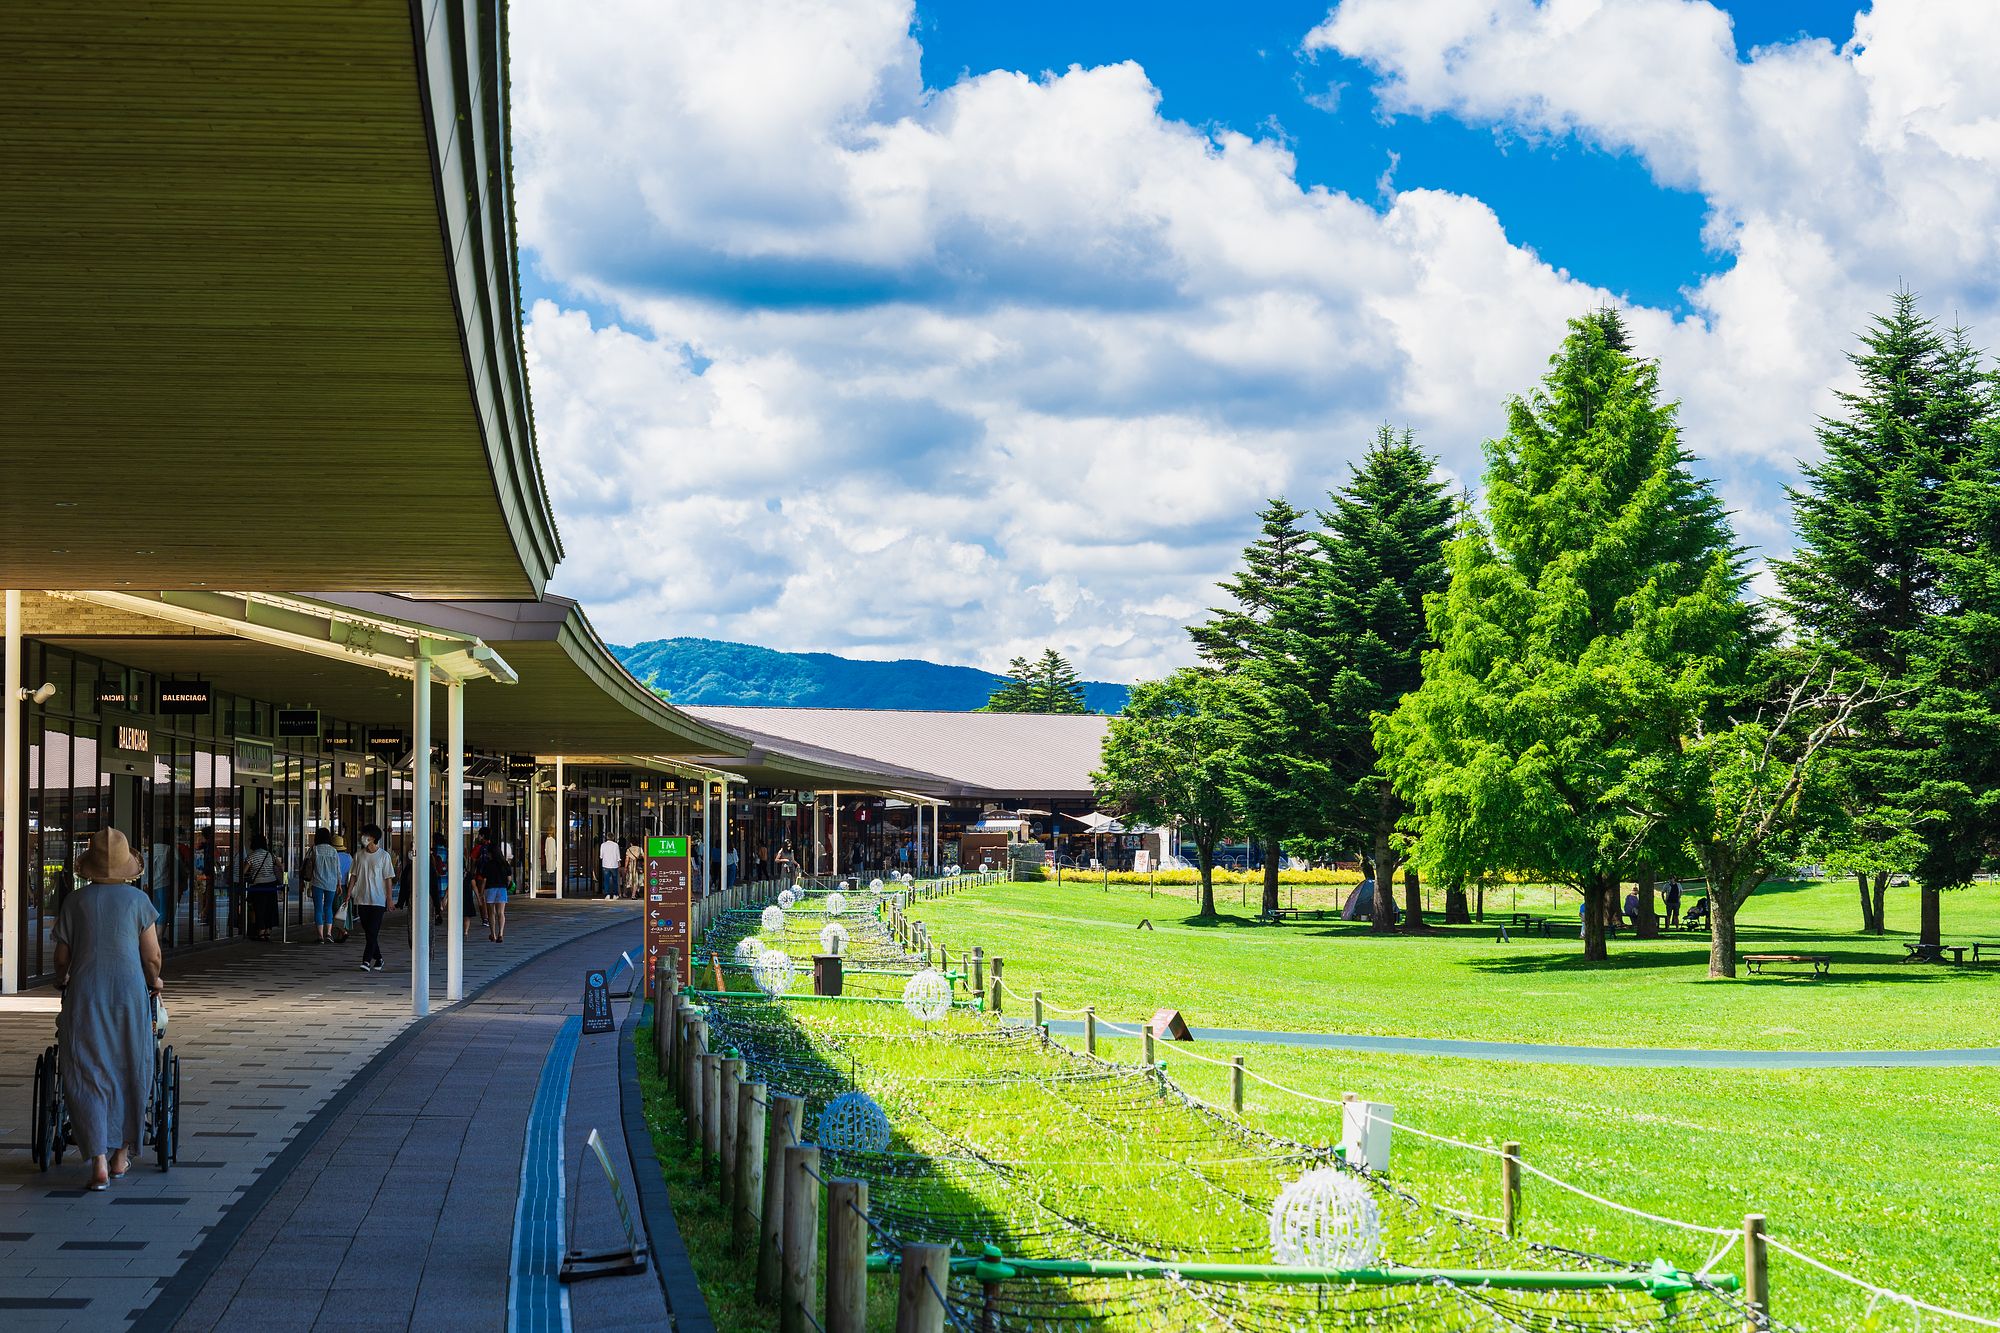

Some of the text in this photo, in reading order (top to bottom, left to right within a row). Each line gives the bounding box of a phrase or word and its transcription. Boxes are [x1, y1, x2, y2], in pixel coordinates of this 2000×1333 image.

[162, 694, 207, 702] BALENCIAGA
[118, 725, 149, 752] BALENCIAGA
[666, 781, 675, 789] UR
[659, 840, 676, 850] TM
